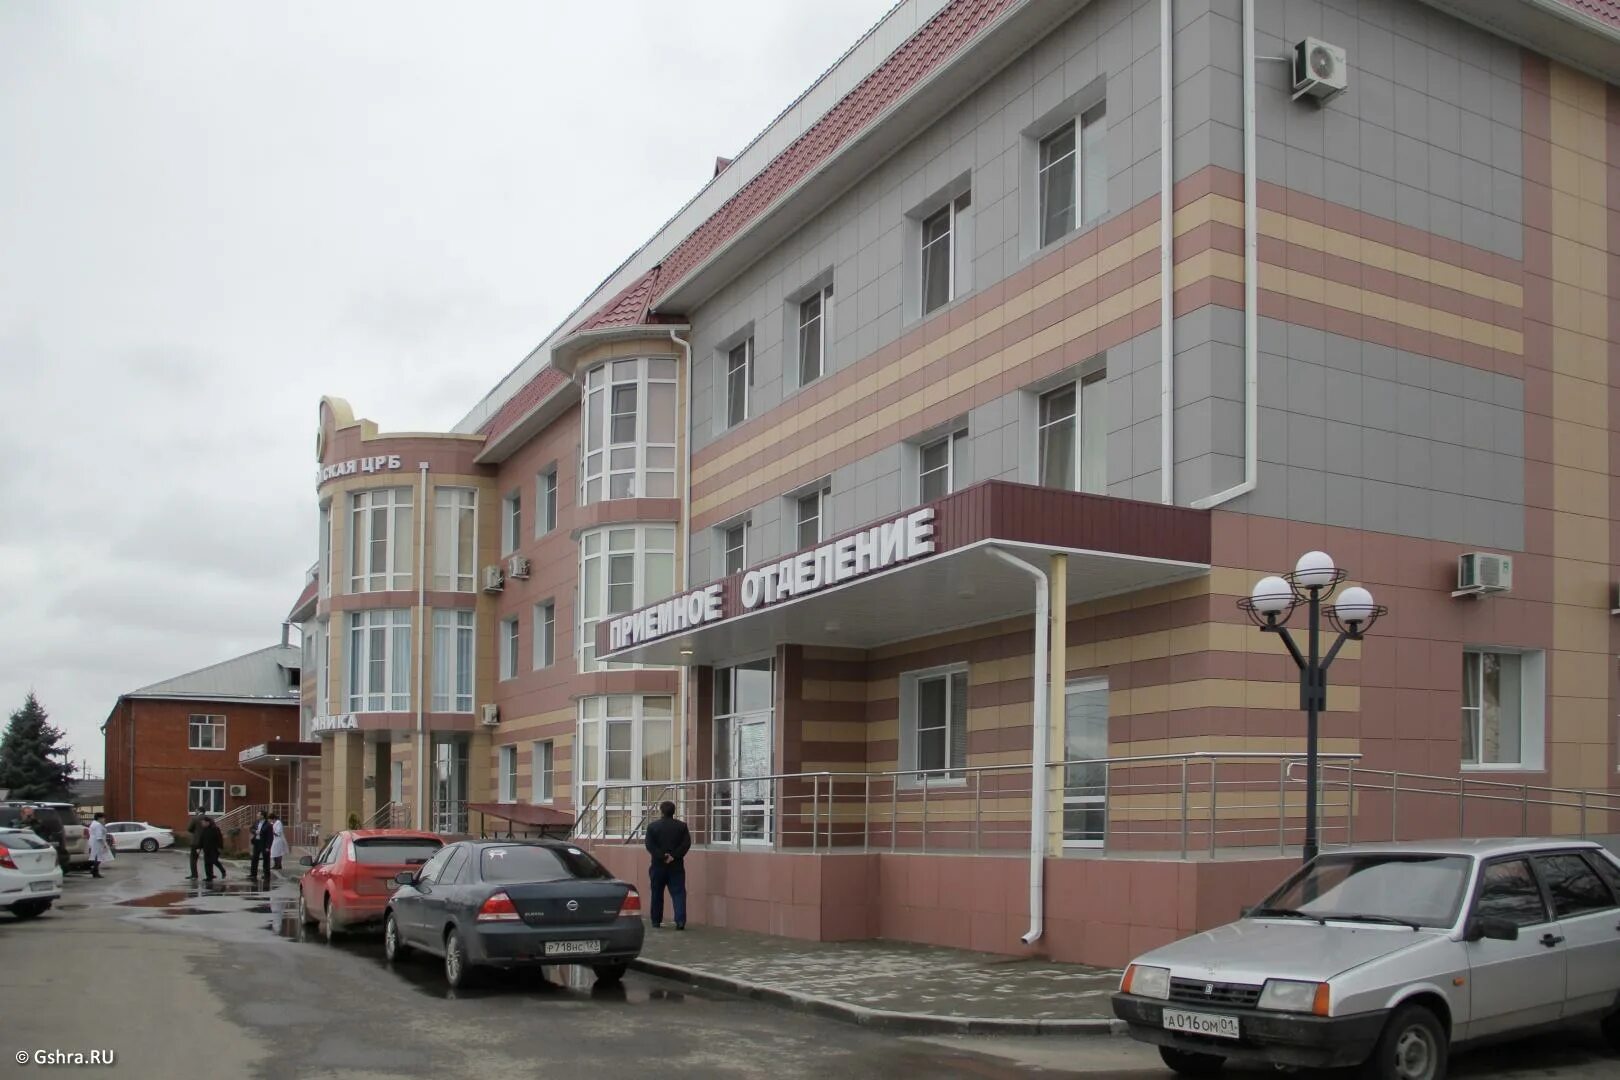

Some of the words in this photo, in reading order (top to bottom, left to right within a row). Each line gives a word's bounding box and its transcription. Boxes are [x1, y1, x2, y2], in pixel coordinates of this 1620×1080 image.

[361, 455, 400, 473] ЦРБ
[610, 584, 723, 650] ПРИЕМНОЕ
[741, 507, 935, 609] ОТДЕЛЕНИЕ
